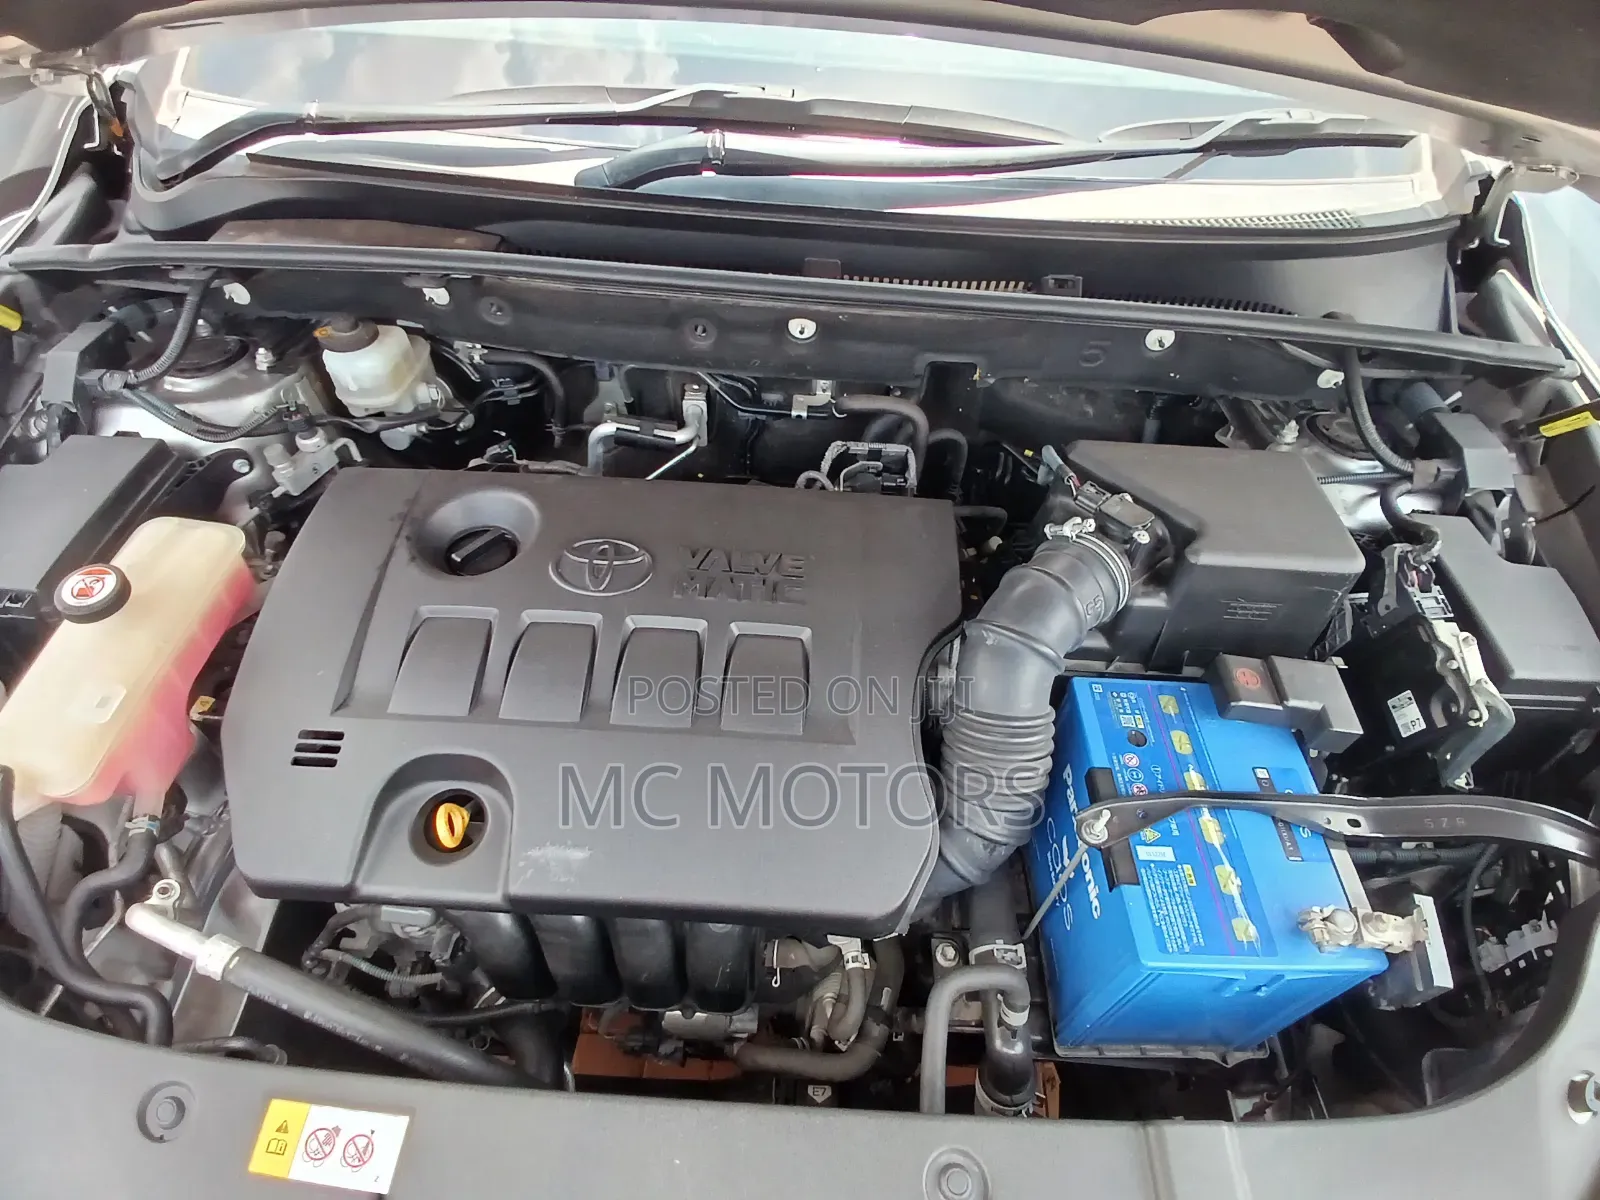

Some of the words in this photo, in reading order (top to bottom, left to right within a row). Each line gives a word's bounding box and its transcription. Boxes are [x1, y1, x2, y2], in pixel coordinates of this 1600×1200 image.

[678, 544, 806, 578] VALVE
[671, 575, 807, 605] MATIC
[1410, 717, 1422, 730] P7
[812, 1086, 827, 1097] E7
